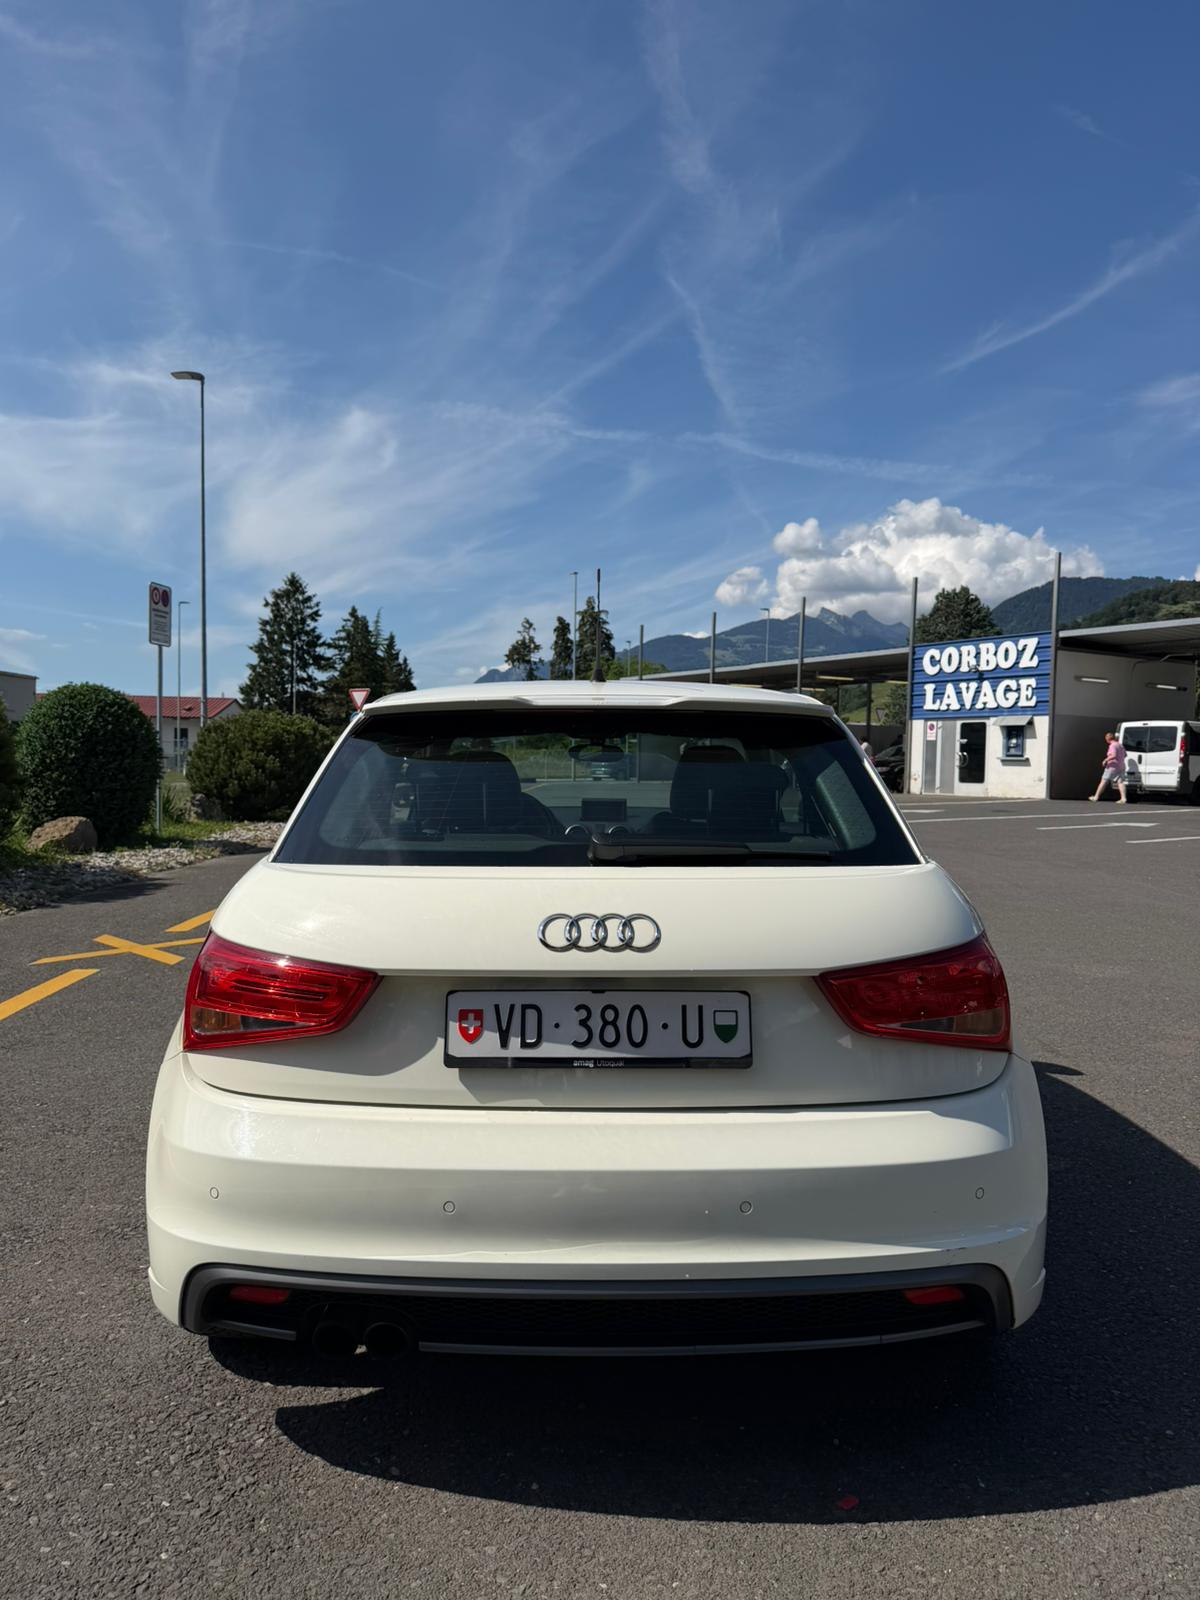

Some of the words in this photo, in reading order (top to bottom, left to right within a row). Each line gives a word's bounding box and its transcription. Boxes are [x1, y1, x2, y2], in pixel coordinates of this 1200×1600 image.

[922, 637, 1039, 675] CORBOZ
[923, 678, 1037, 711] LAVAGE
[573, 1060, 594, 1068] amag
